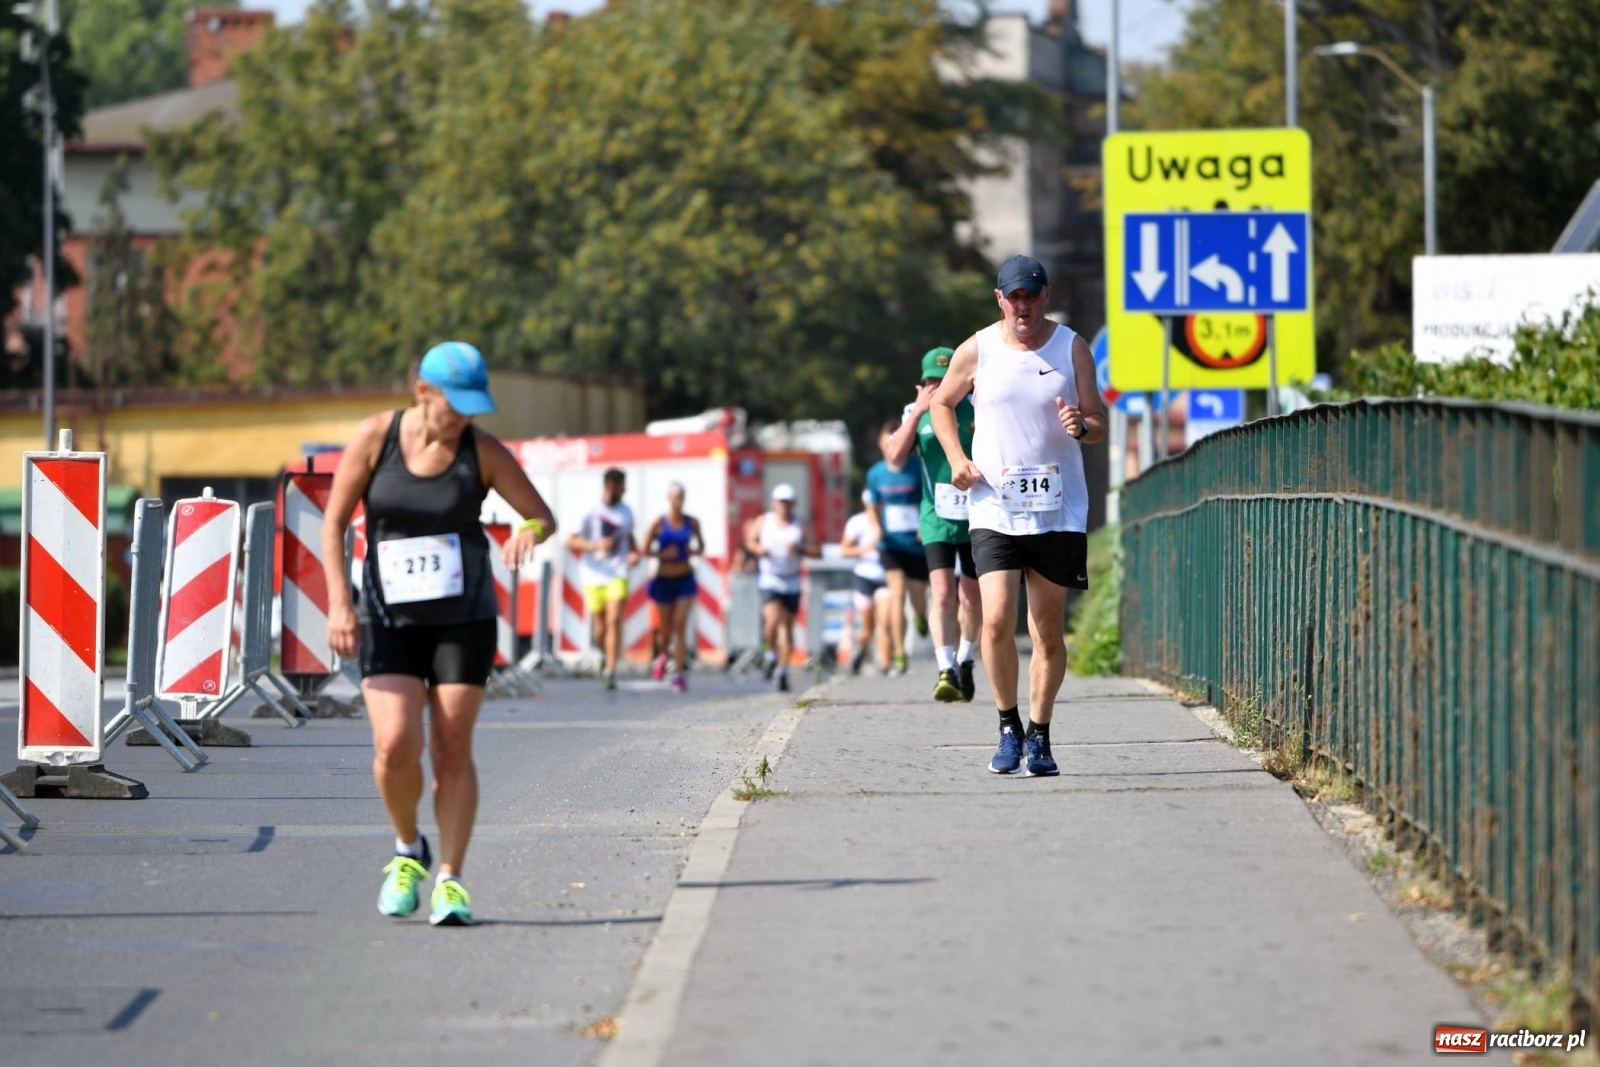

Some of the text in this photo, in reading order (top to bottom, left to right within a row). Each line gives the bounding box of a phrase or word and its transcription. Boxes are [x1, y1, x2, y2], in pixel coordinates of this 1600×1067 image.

[1127, 146, 1285, 191] Uwaga
[1020, 477, 1050, 494] 314
[405, 553, 441, 575] 273
